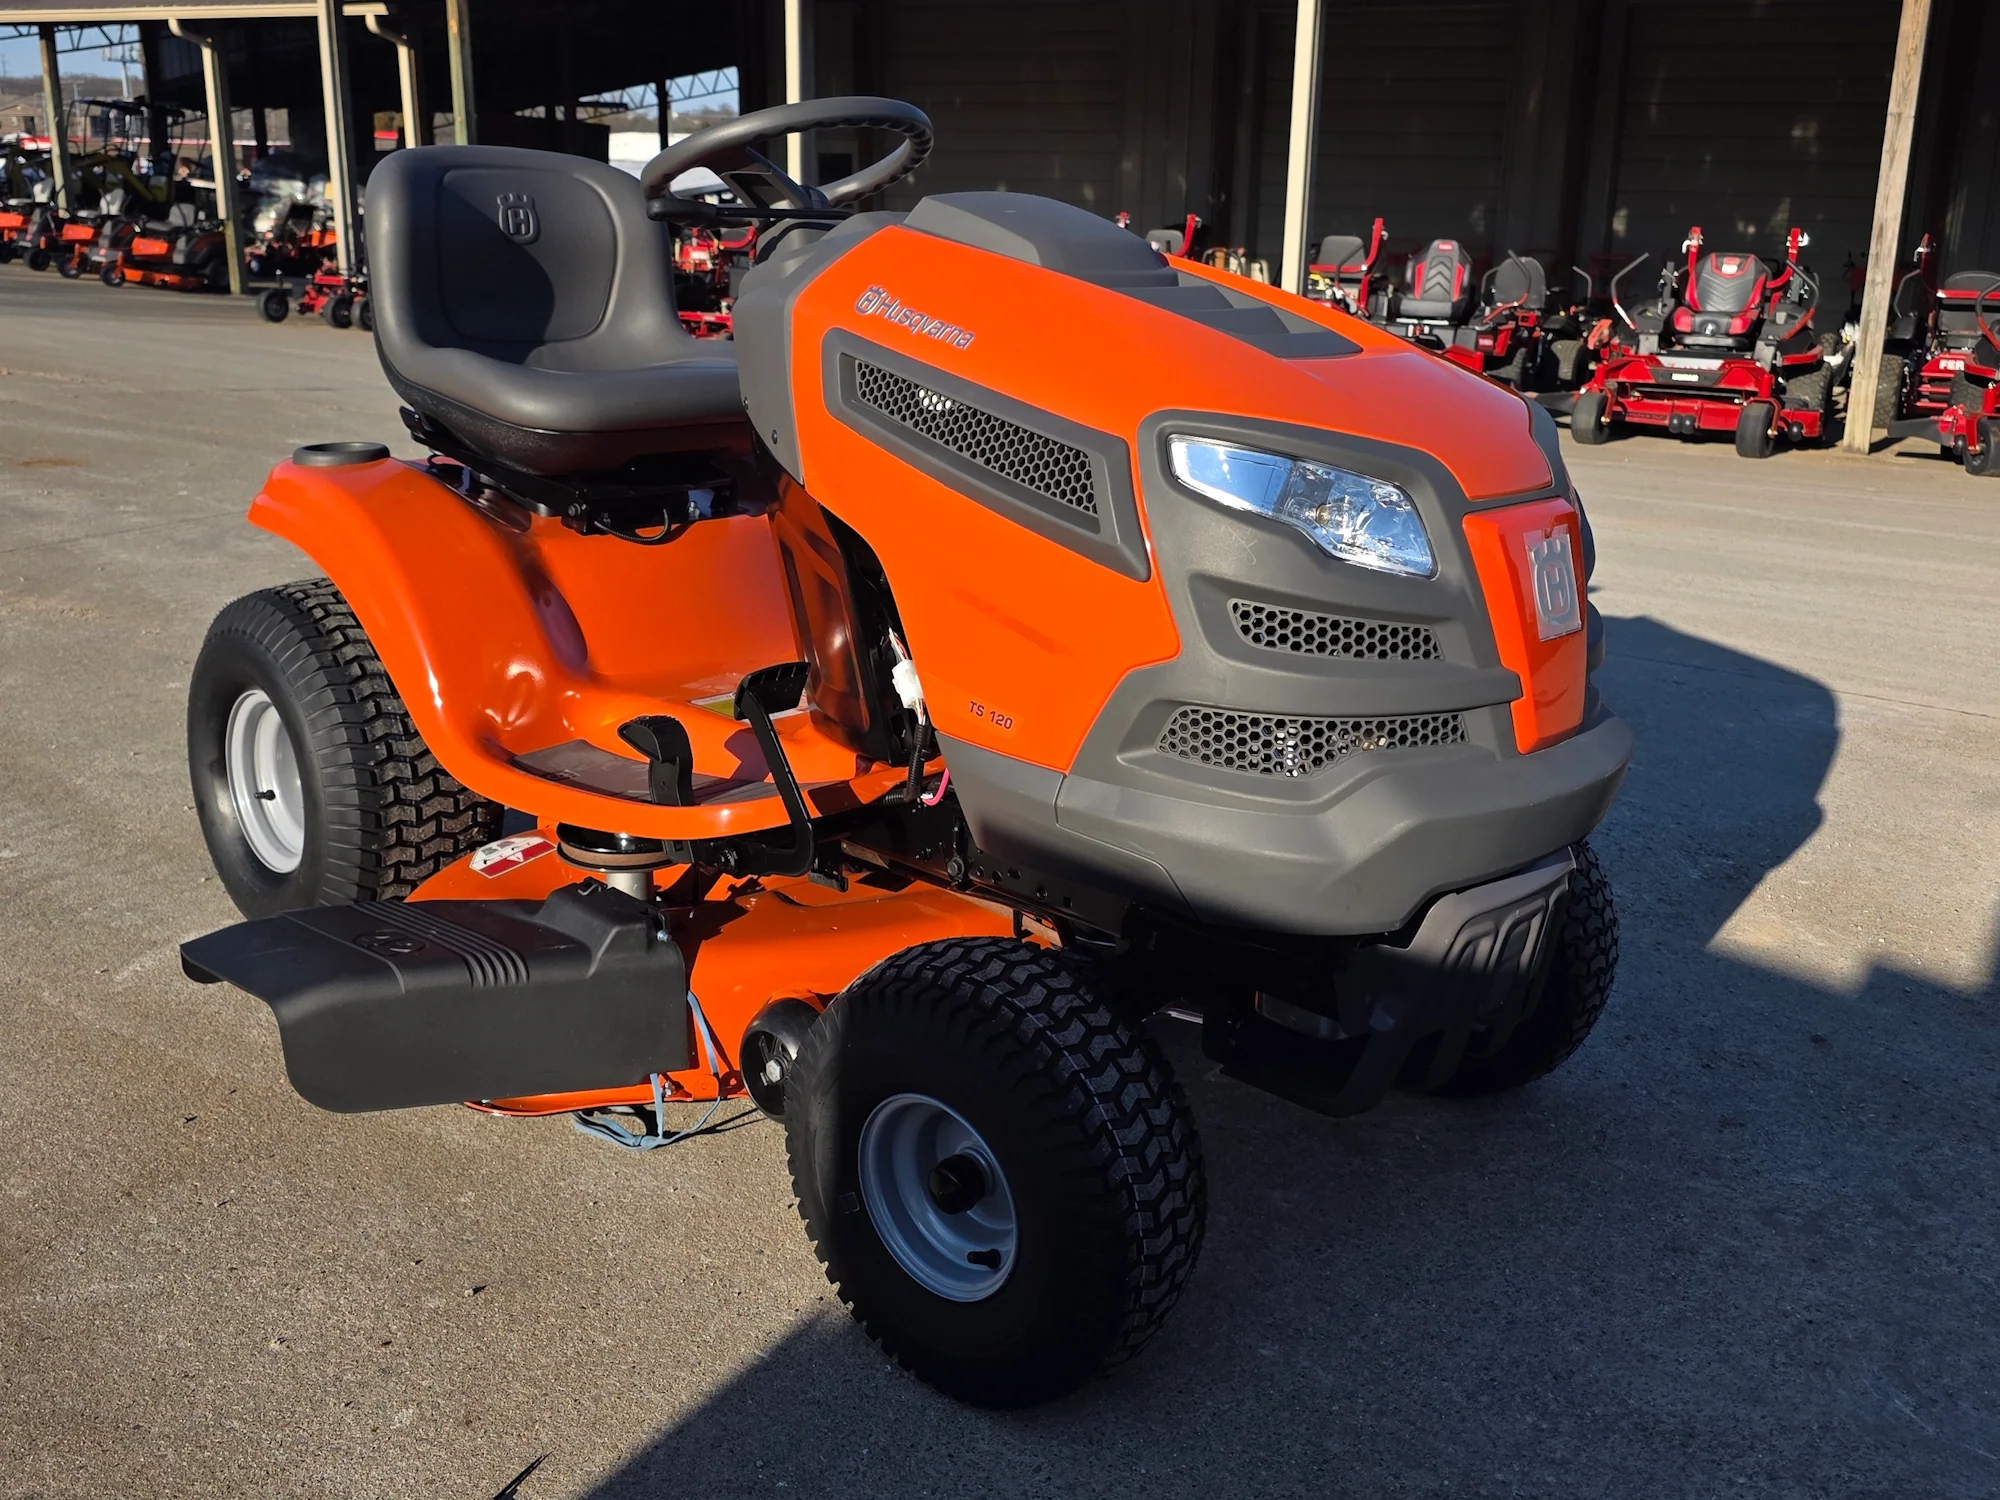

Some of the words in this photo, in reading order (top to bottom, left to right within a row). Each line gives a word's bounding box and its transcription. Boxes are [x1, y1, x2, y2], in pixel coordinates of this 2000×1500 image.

[875, 292, 975, 350] Husqvarna
[969, 700, 985, 717] TS
[989, 710, 1013, 730] 120
